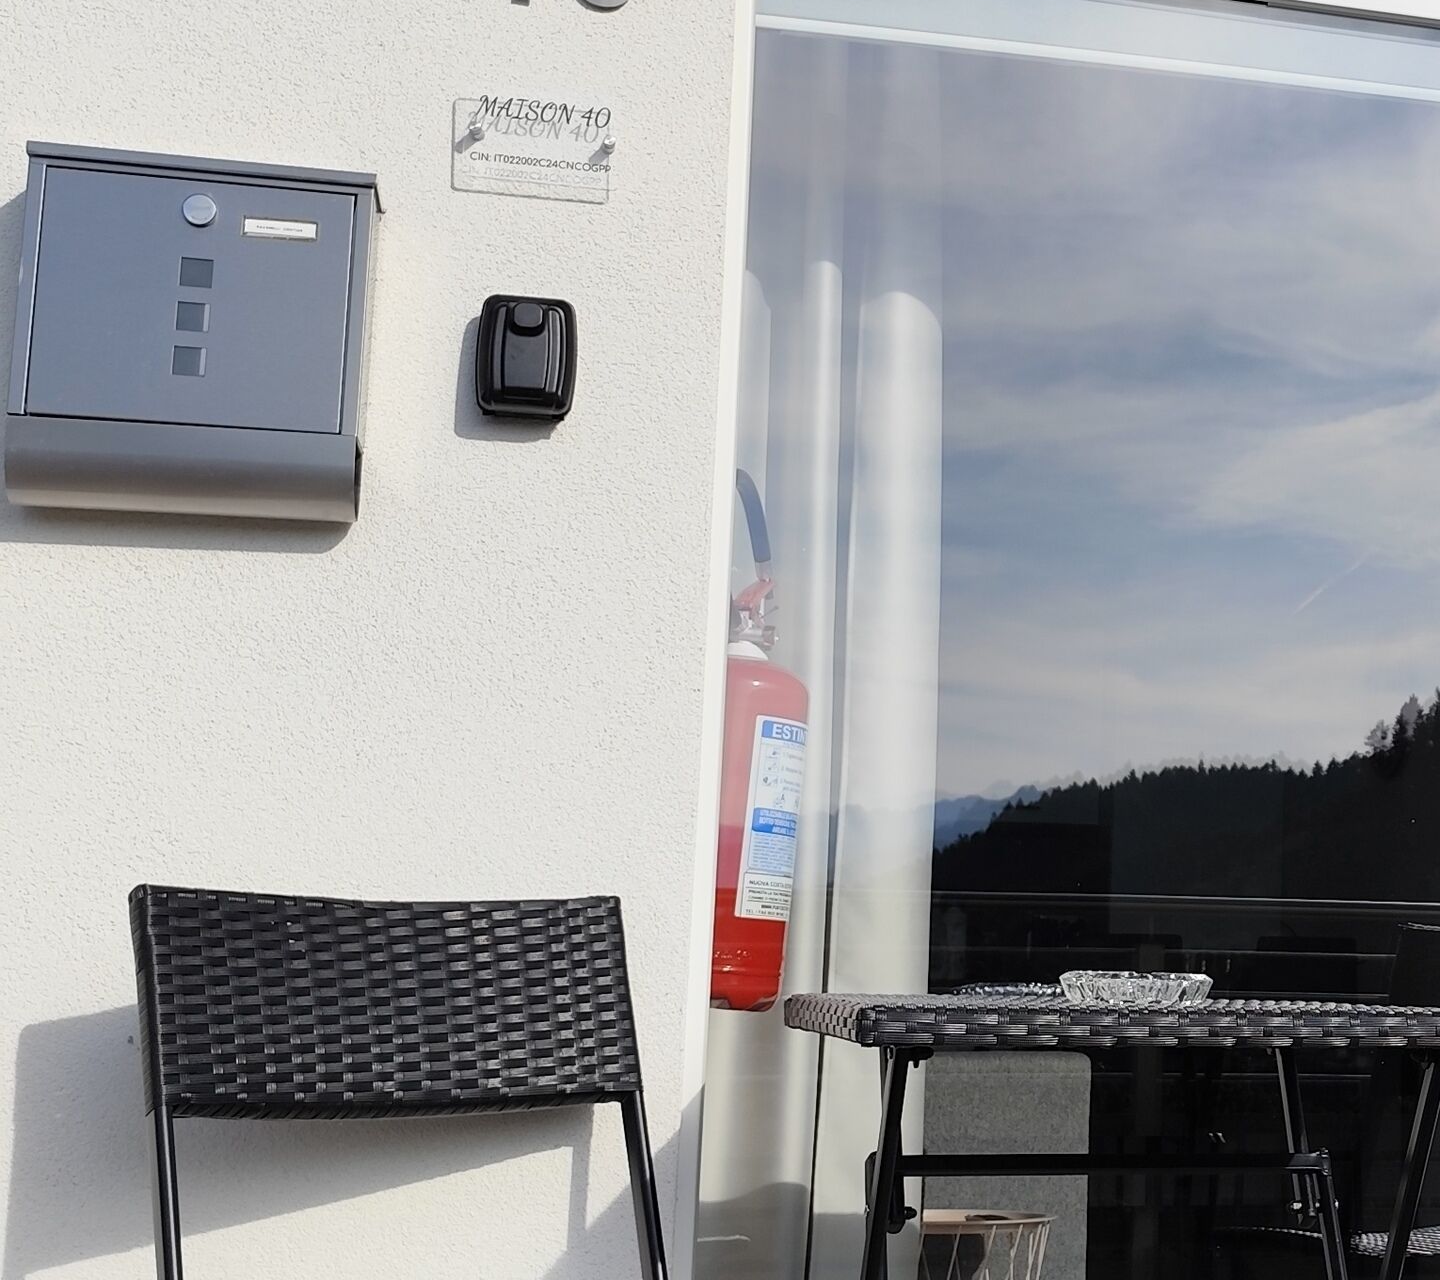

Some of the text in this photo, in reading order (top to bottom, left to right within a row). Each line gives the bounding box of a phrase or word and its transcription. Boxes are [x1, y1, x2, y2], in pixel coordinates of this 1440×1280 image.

[476, 95, 611, 128] MAISON 40
[470, 152, 491, 162] CIN:
